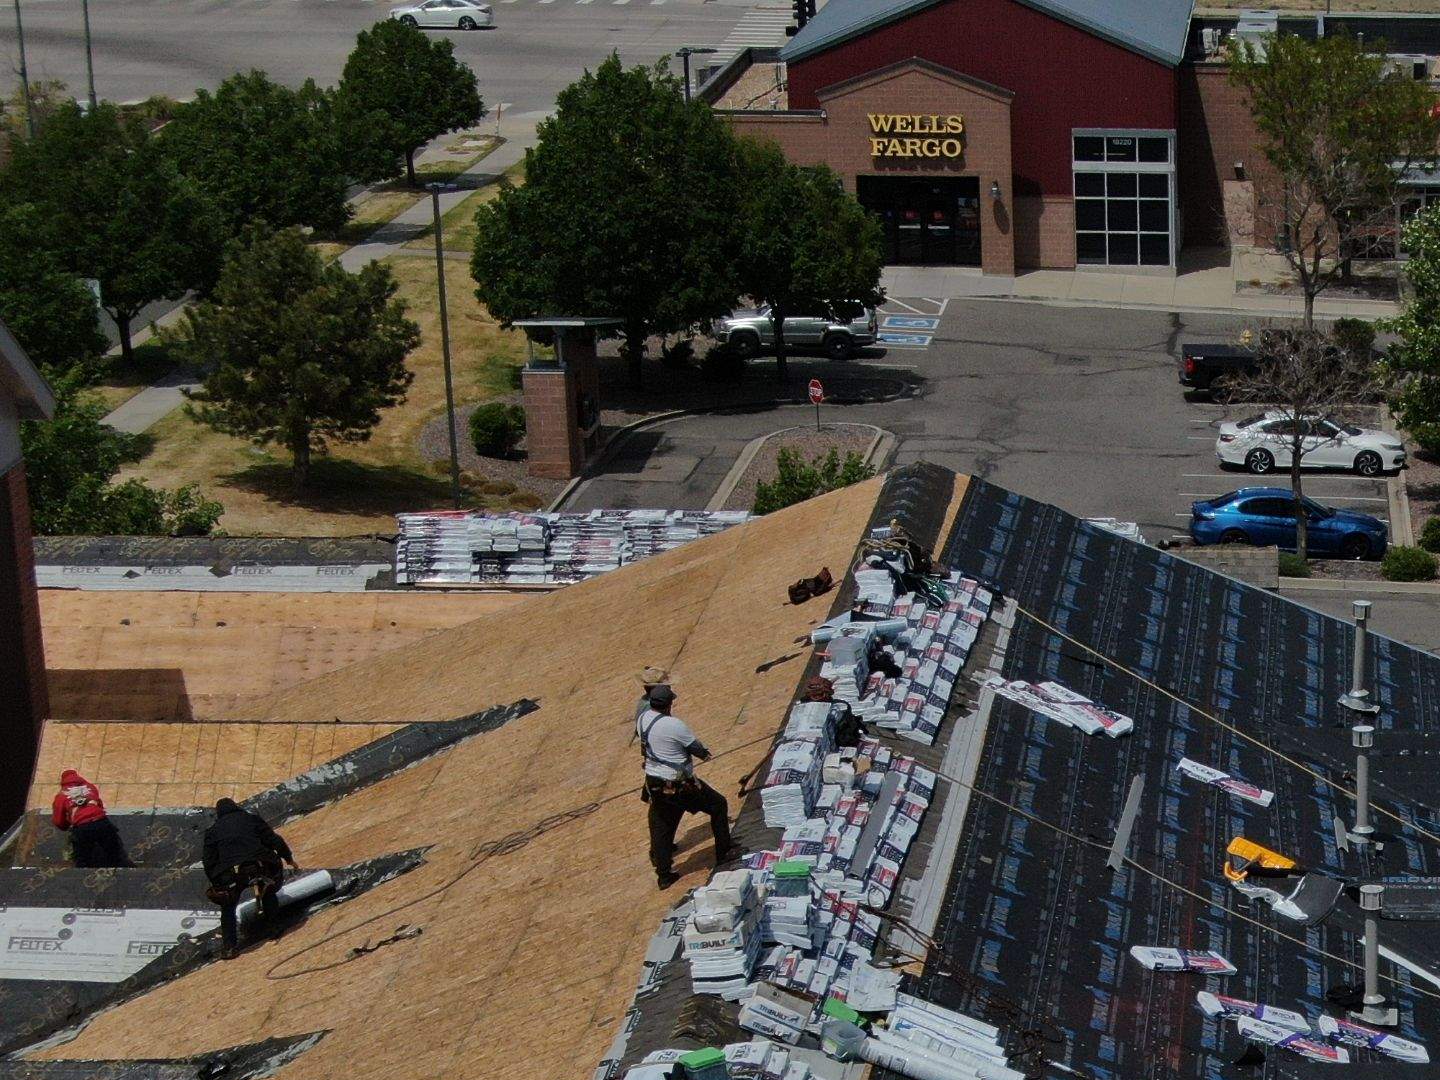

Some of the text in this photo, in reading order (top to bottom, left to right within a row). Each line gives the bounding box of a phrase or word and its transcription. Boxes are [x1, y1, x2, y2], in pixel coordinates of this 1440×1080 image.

[867, 112, 963, 134] WELLS
[868, 136, 962, 158] FARGO
[8, 936, 65, 952] FELTEX
[127, 940, 172, 955] FELTE
